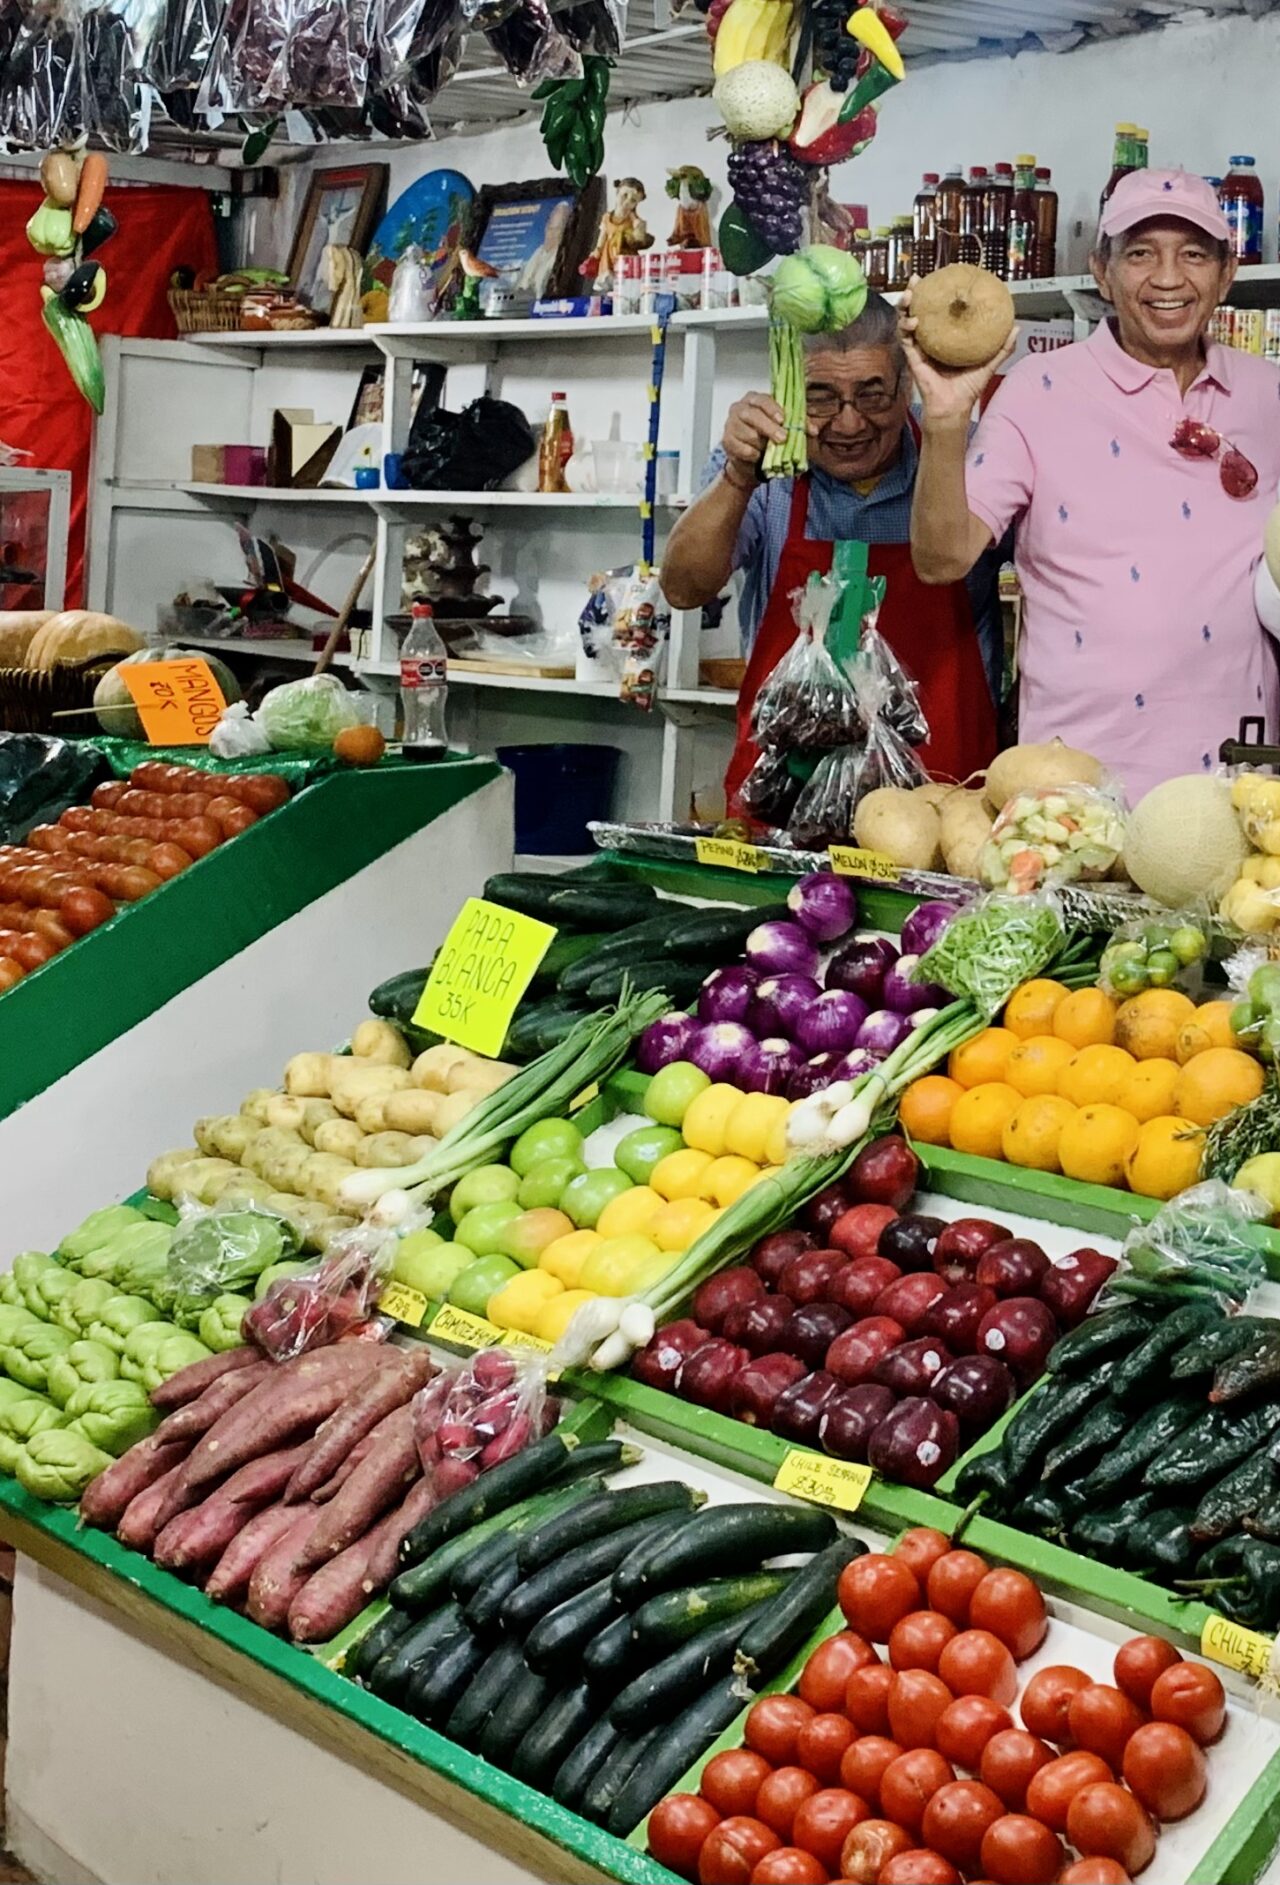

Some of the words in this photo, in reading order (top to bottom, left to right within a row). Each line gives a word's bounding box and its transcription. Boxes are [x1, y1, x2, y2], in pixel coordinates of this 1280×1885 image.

[168, 664, 222, 736] MANGOS
[832, 852, 868, 871] MELON
[461, 910, 515, 955] PAPA
[435, 948, 517, 1000] BLANCA
[438, 992, 477, 1024] 35K
[790, 1456, 823, 1472] CHILE
[1210, 1622, 1257, 1660] CHILE
